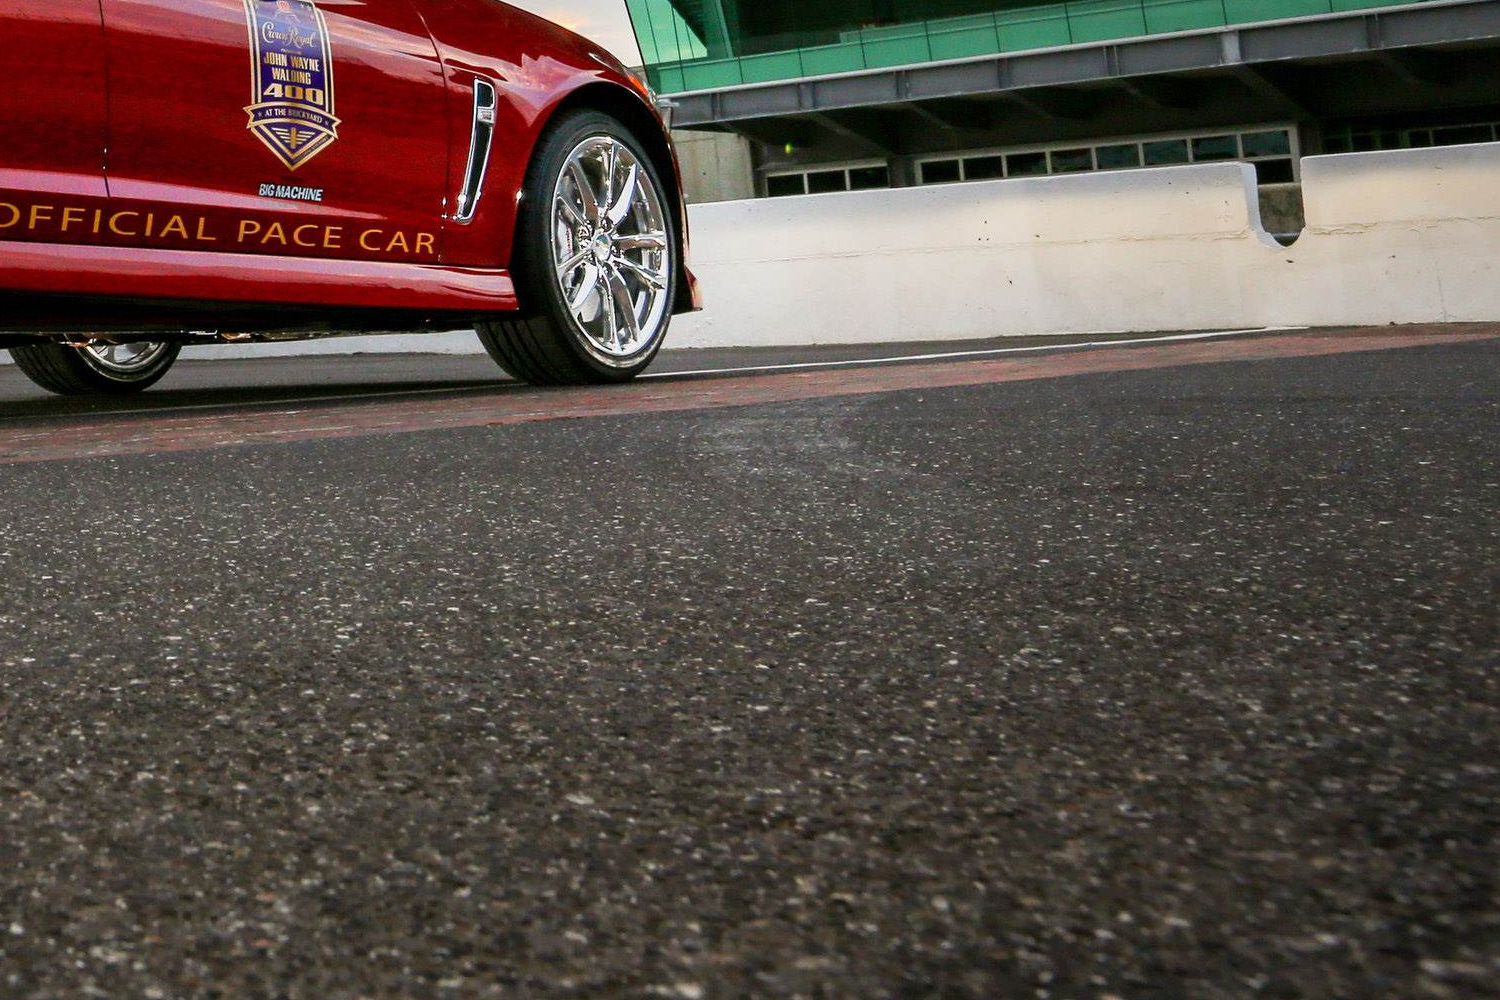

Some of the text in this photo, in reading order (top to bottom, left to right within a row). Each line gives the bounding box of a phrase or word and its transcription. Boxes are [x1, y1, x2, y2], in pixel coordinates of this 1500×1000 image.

[262, 21, 317, 49] Crown Royal
[264, 51, 288, 67] JOHN
[291, 56, 320, 71] WAYNE
[272, 67, 311, 84] WALDING
[263, 83, 323, 105] 400
[265, 108, 323, 123] AT THE BRICKYARD
[259, 184, 323, 201] BIG MACHINE
[237, 219, 343, 249] PACE
[359, 229, 435, 255] CAR
